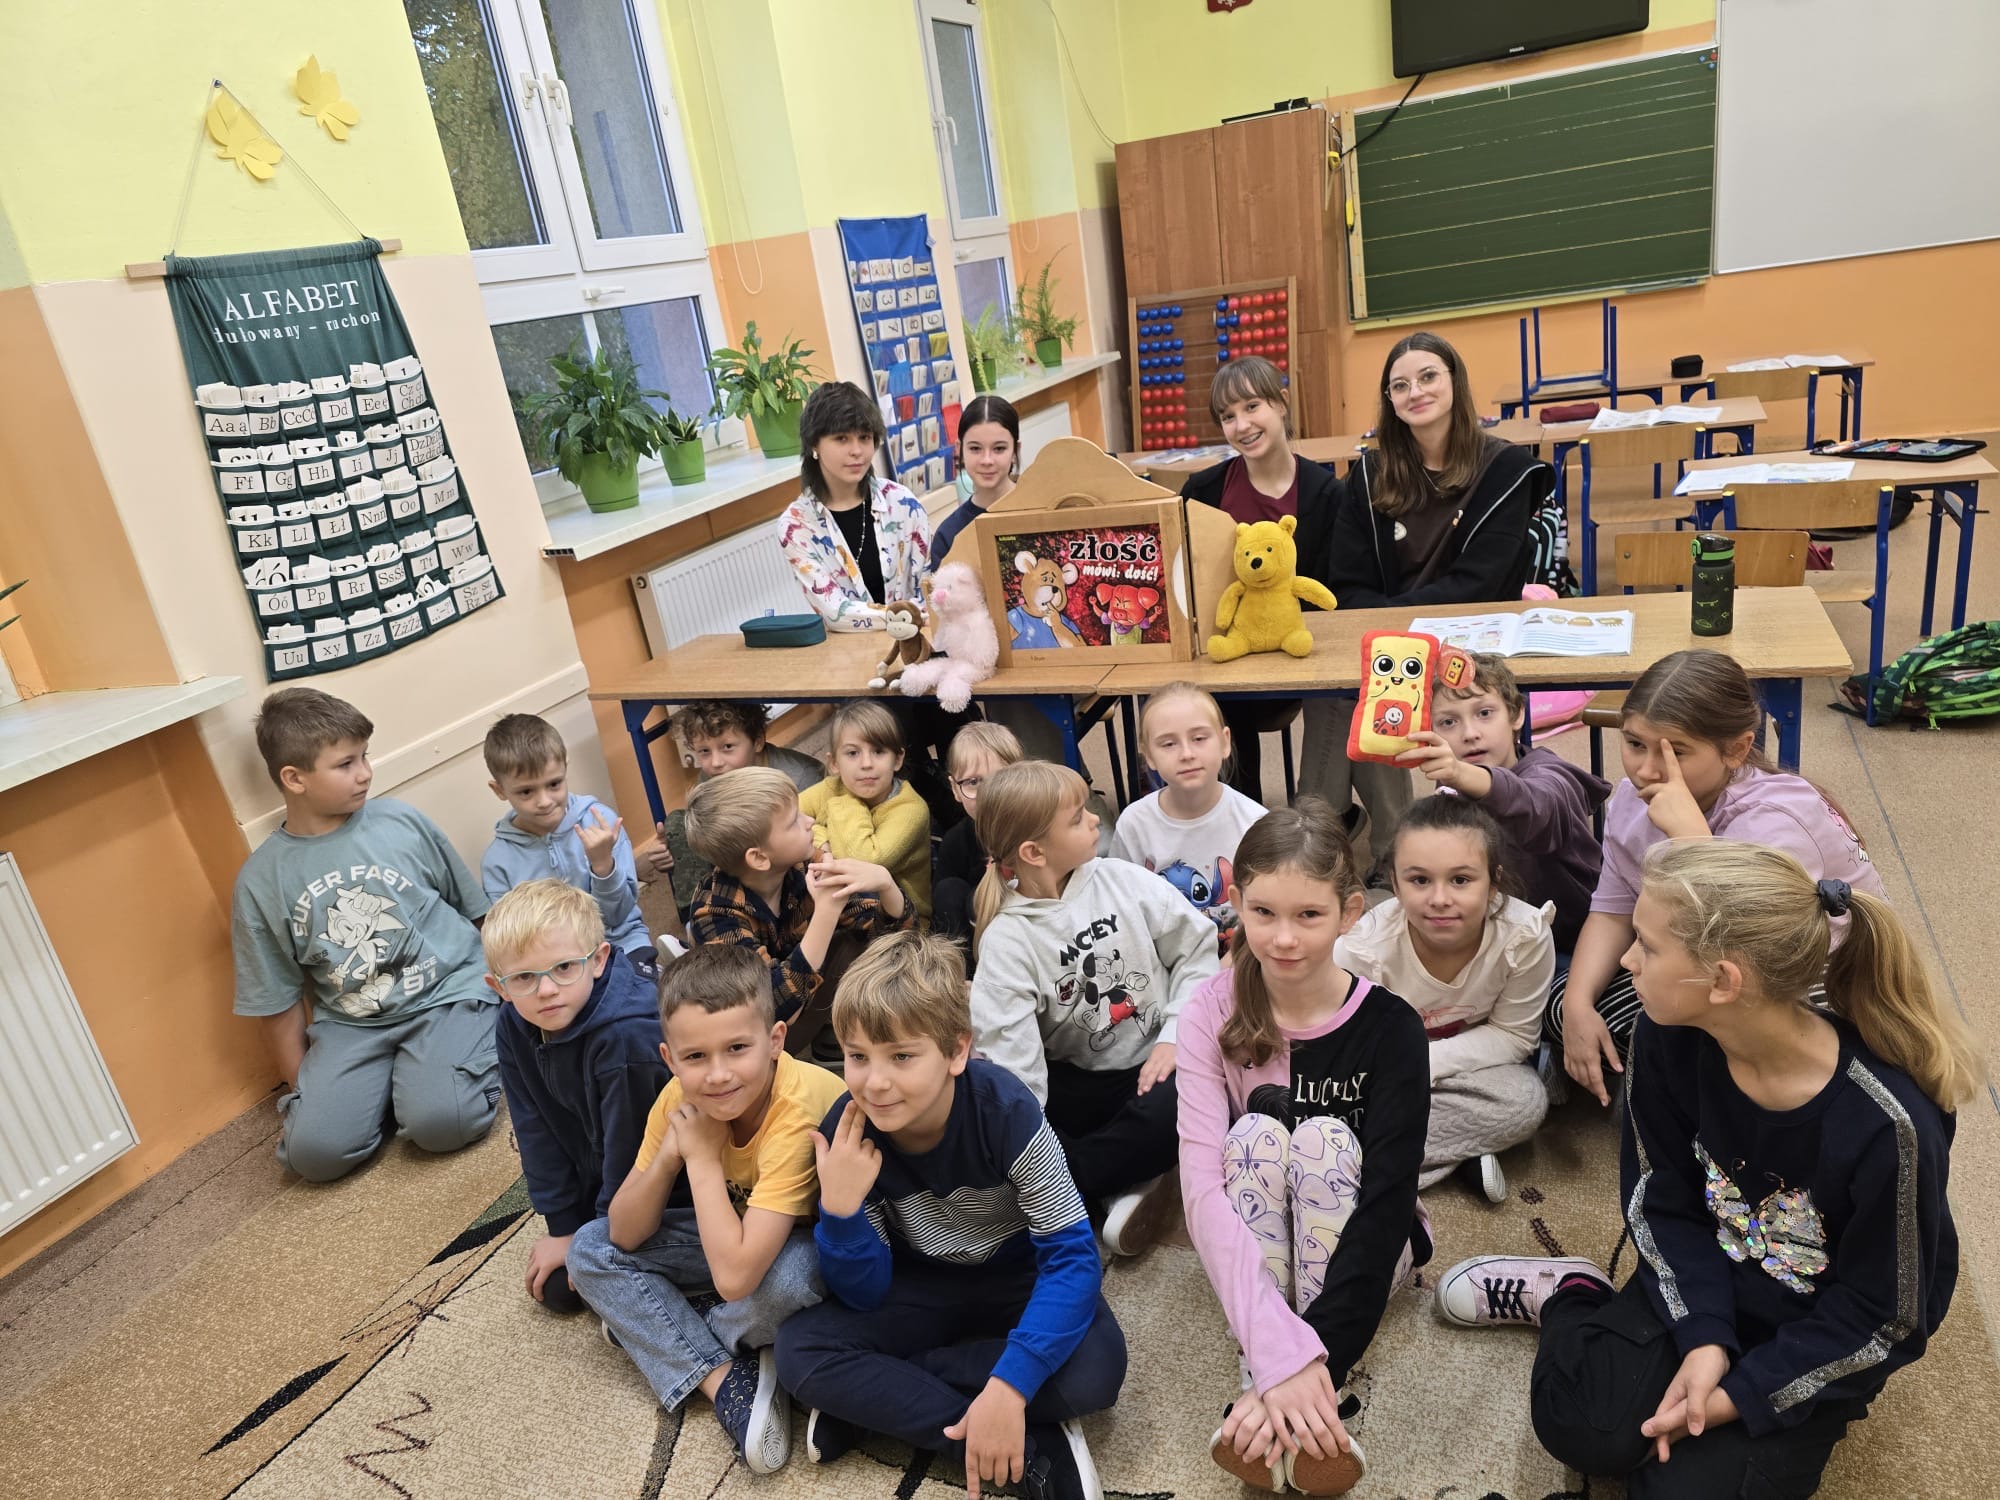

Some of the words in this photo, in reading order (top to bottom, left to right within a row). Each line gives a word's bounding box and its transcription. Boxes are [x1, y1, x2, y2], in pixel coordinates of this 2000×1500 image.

[224, 280, 360, 322] ALFABET
[330, 402, 348, 418] Dd
[259, 416, 277, 431] Bb
[386, 448, 399, 465] Jj
[308, 465, 330, 481] Hh
[352, 458, 363, 472] Ii
[234, 476, 253, 490] Ff
[275, 471, 294, 490] Gg
[400, 501, 416, 513] Oo
[329, 518, 346, 534] Łł
[248, 533, 273, 548] Kk
[292, 527, 308, 542] Ll
[451, 543, 474, 559] Ww
[1069, 535, 1157, 562] złość
[420, 557, 433, 570] Tt
[1082, 563, 1120, 578] mówi:
[1124, 564, 1159, 581] dość!
[348, 581, 366, 595] Rr
[268, 593, 289, 611] Óó
[307, 588, 326, 605] Pp
[364, 633, 382, 648] Zz
[283, 652, 304, 666] Uu
[292, 870, 345, 937] SUPER
[350, 864, 413, 892] FAST
[402, 955, 438, 976] SINCE
[403, 966, 439, 996] 91
